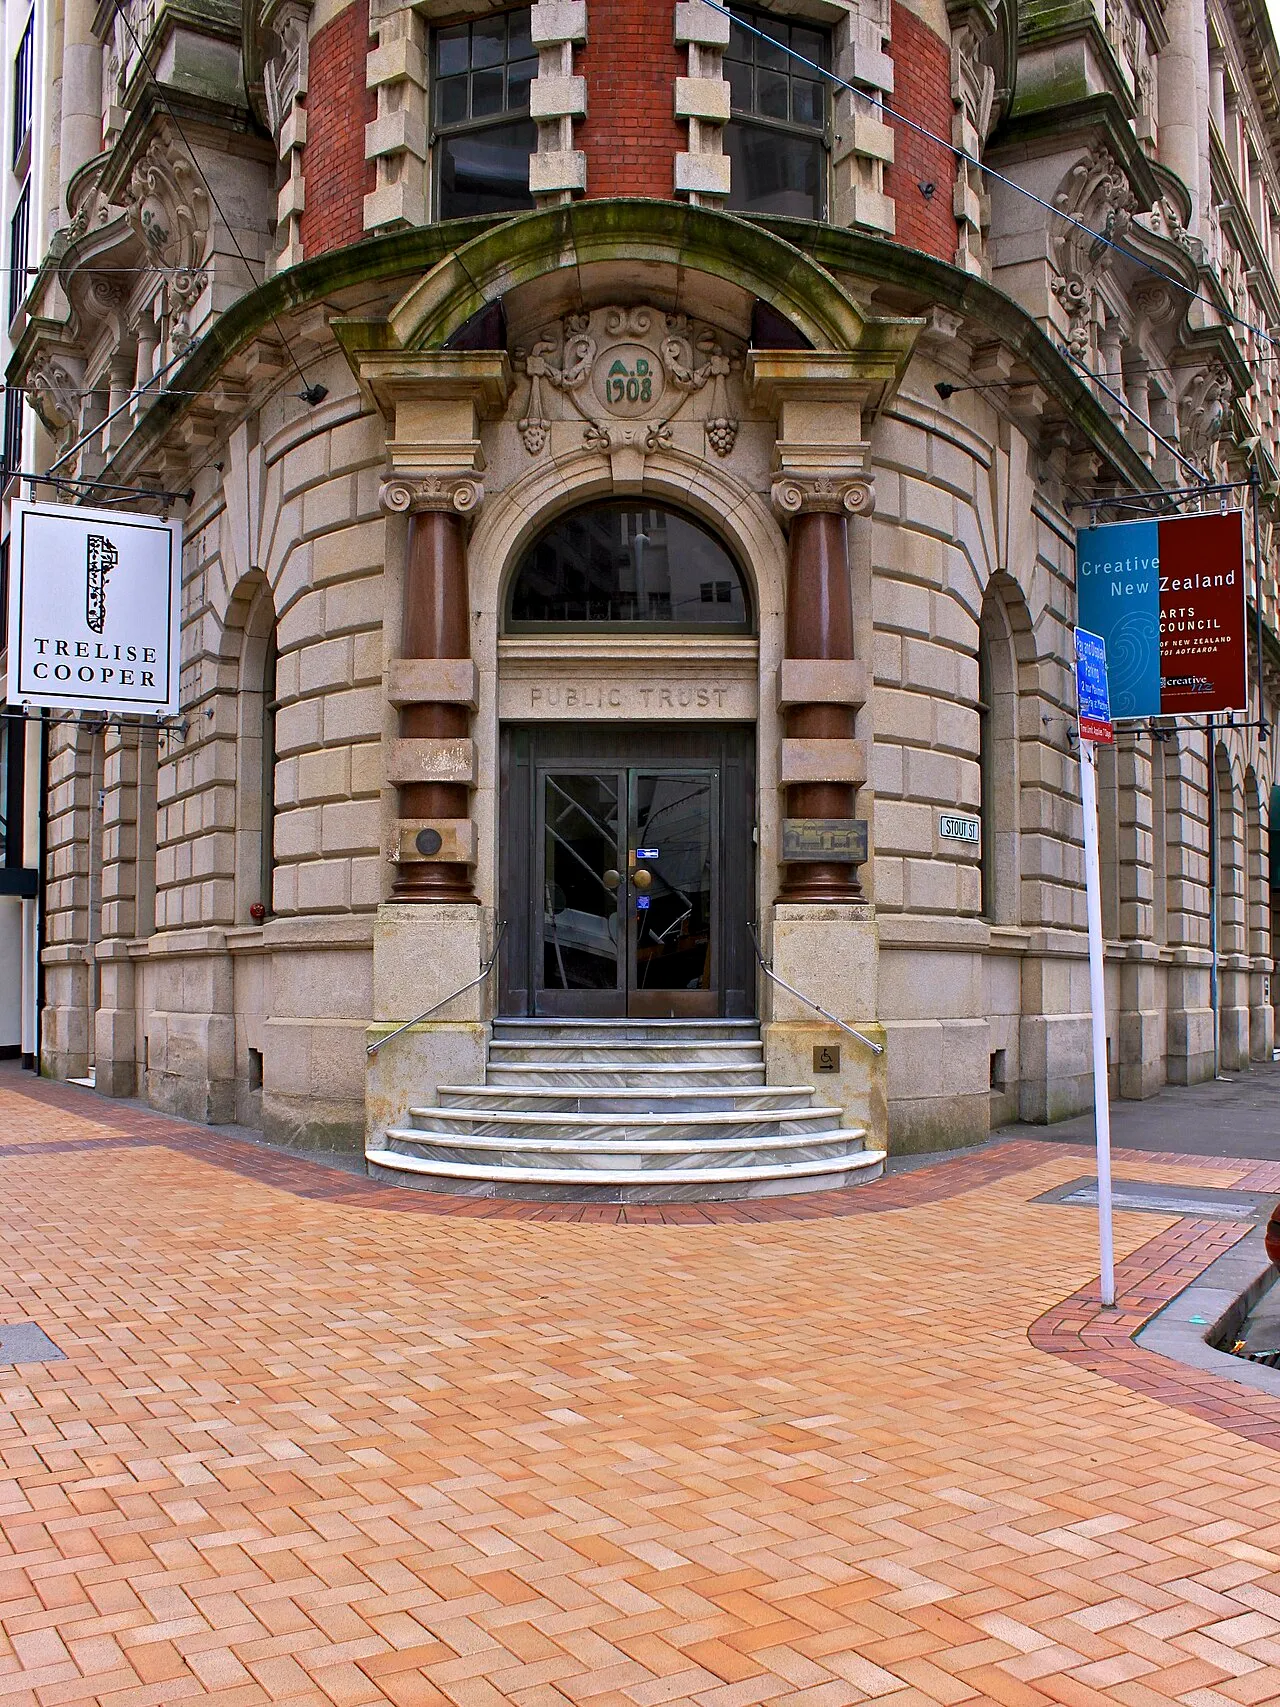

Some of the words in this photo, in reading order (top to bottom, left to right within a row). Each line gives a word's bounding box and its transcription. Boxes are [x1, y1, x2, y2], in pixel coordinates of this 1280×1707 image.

[608, 359, 653, 377] A.D.
[606, 377, 653, 404] 1908
[1082, 556, 1160, 576] Creative
[1111, 581, 1149, 597] New
[1159, 569, 1235, 592] Zealand
[1160, 607, 1195, 619] ARTS
[1160, 618, 1221, 633] COUNCIL
[34, 638, 157, 663] TRELISE
[1160, 640, 1169, 648] OF
[1193, 635, 1232, 645] ZEALAND
[1175, 646, 1218, 655] AOTEAROA
[33, 663, 156, 687] COOPER
[1166, 675, 1207, 686] creative
[530, 688, 621, 708] PUBLIC
[639, 688, 728, 708] TRUST
[946, 819, 967, 836] STOUT
[968, 823, 976, 838] ST
